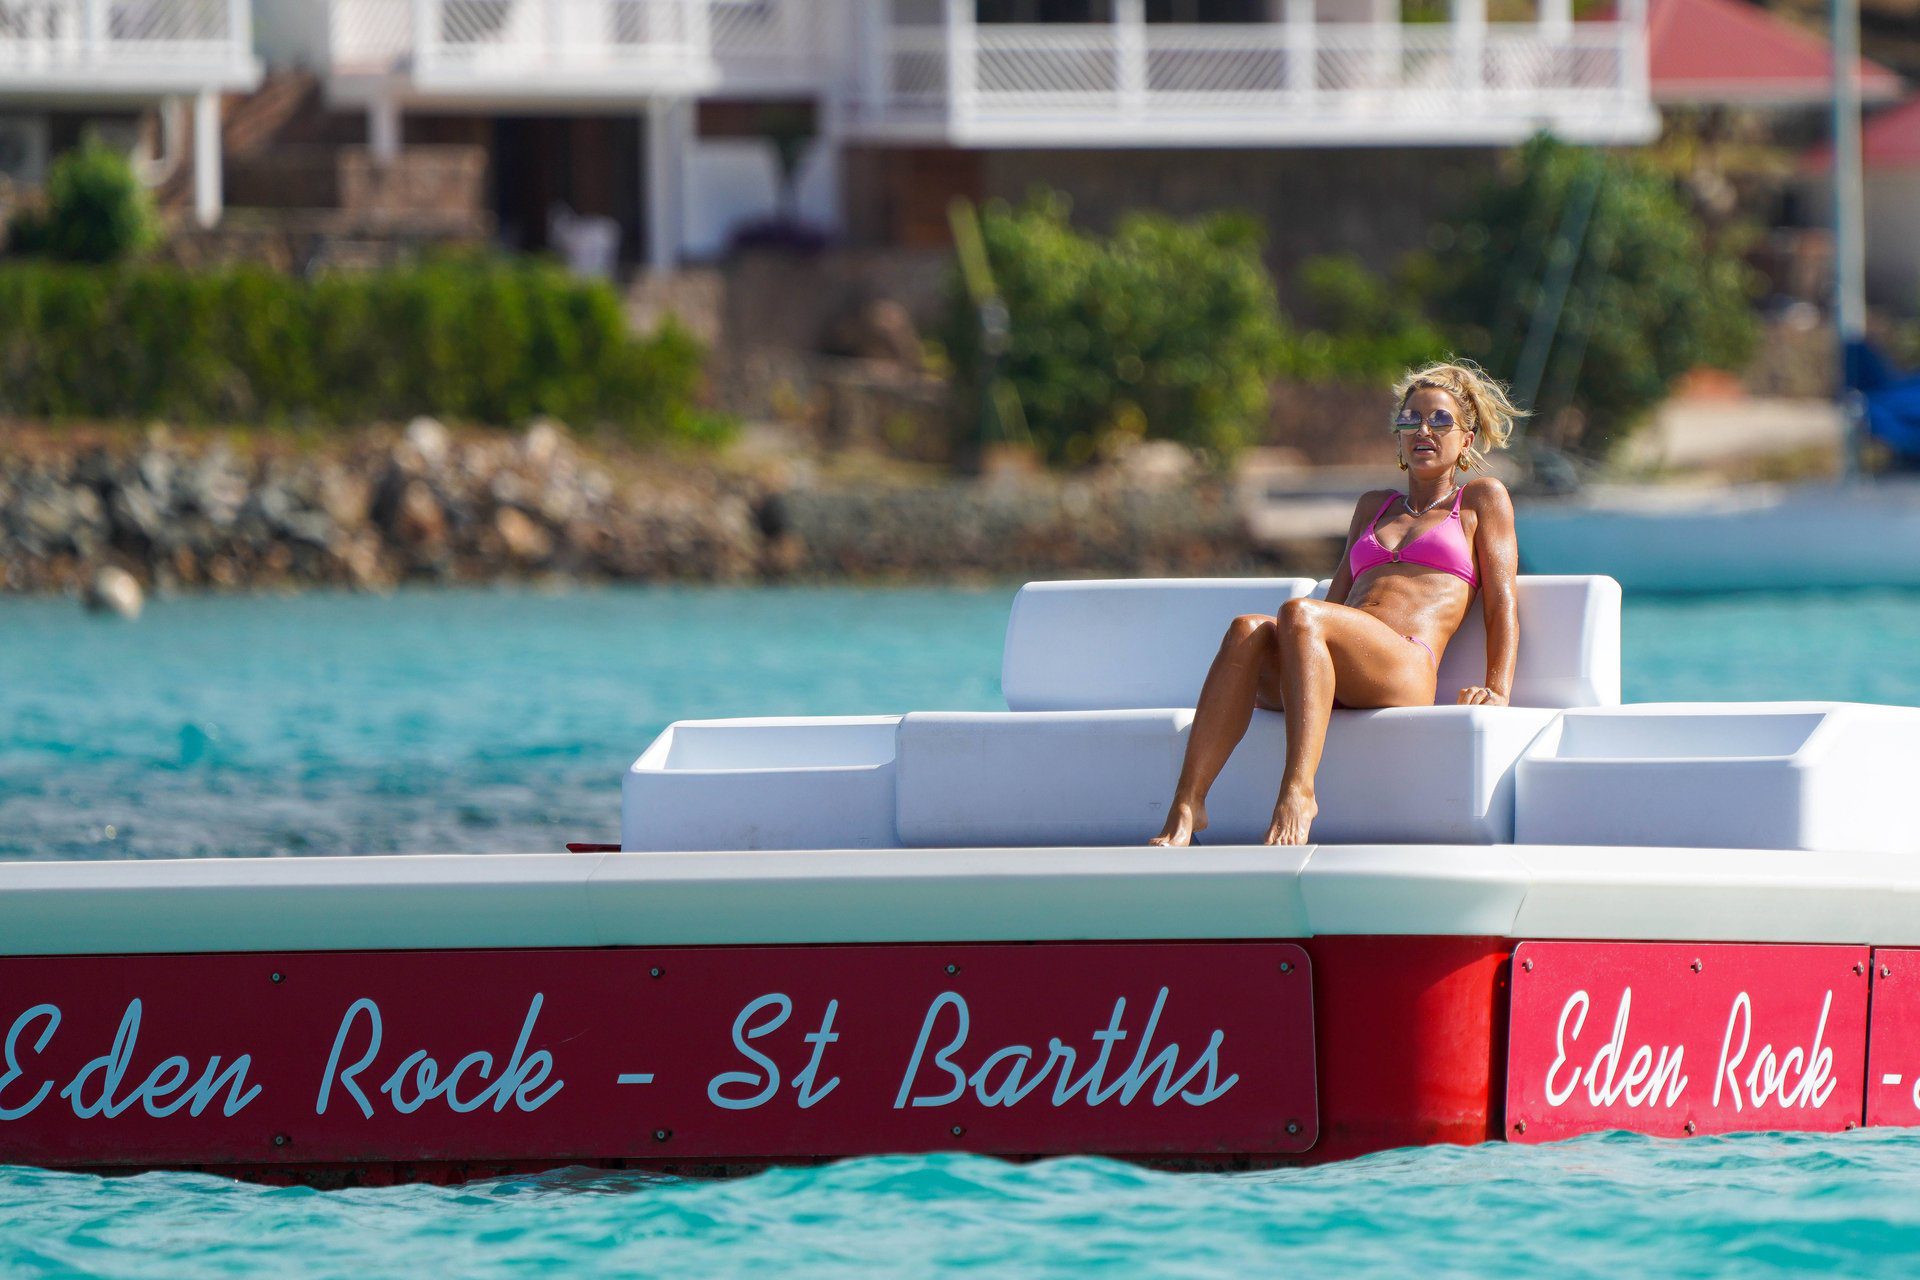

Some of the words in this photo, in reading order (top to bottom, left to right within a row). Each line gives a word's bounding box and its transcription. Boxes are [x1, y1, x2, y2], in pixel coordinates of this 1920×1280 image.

[0, 998, 262, 1121] Eden
[316, 992, 564, 1119] Rock
[707, 992, 840, 1110] St
[894, 986, 1239, 1109] Barths
[1544, 986, 1688, 1108] Eden
[1712, 989, 1837, 1112] Rock
